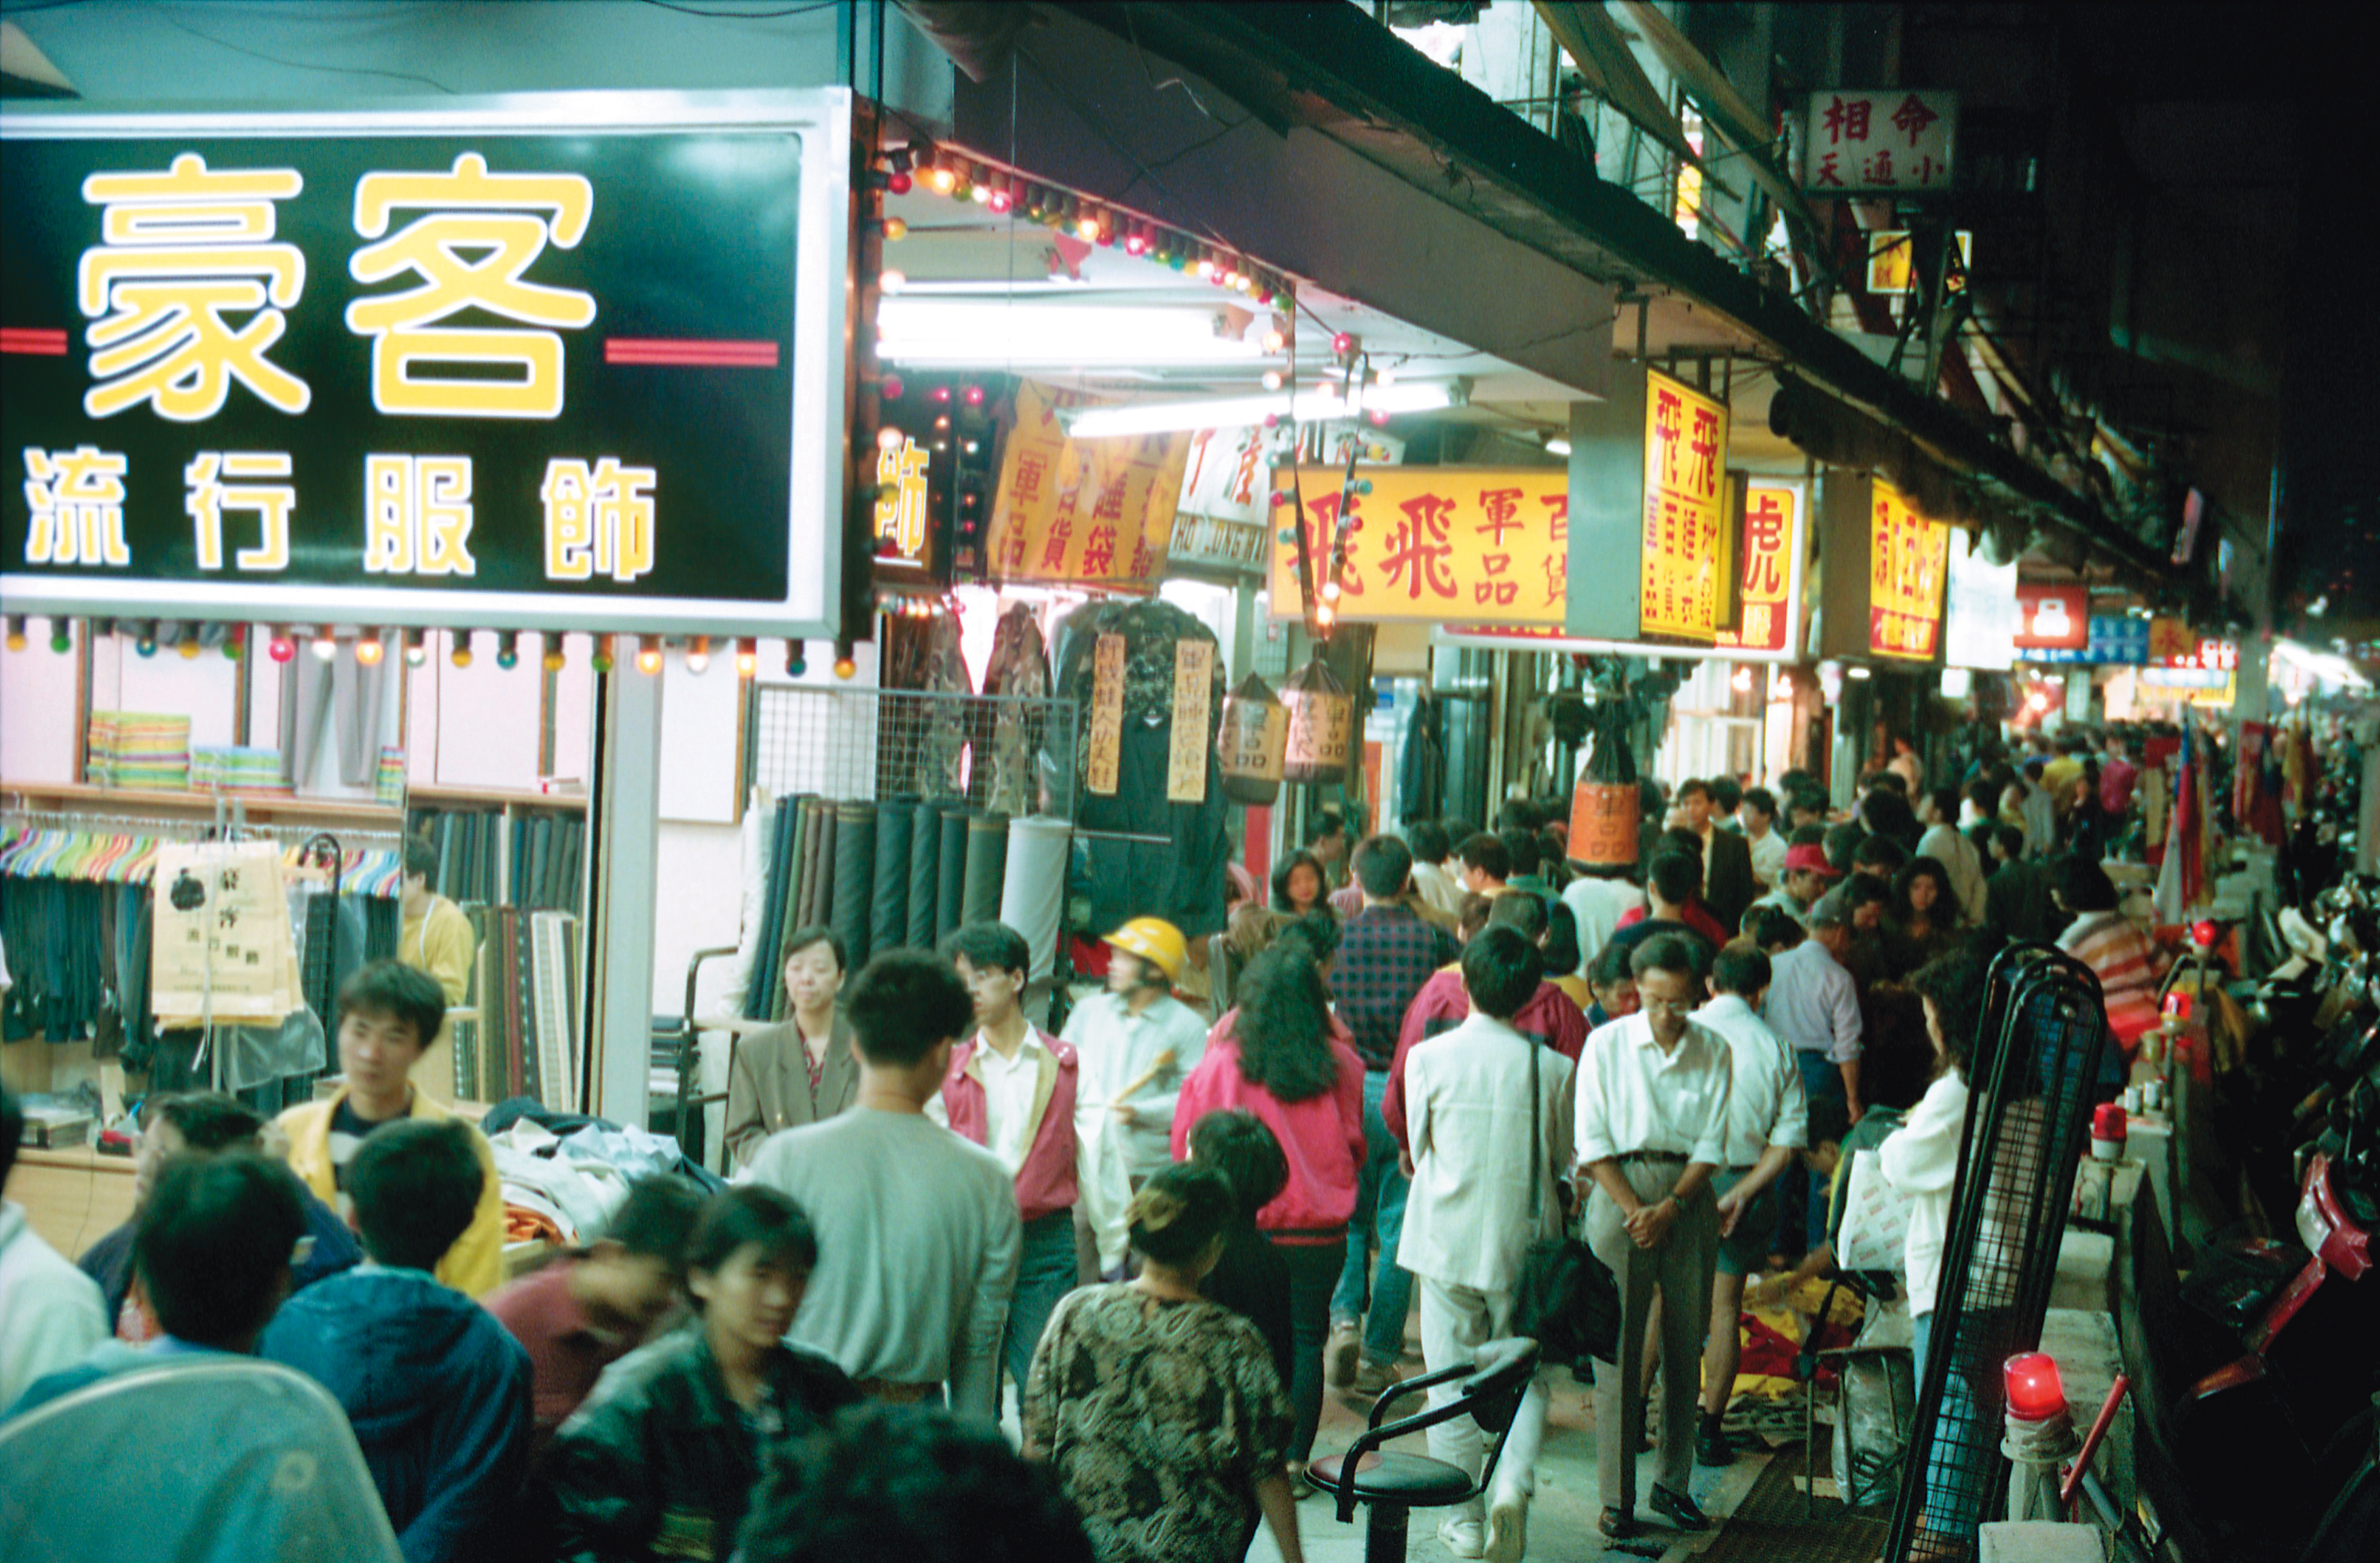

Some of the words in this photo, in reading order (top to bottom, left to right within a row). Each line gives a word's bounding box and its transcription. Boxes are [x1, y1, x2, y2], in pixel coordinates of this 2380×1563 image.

[79, 153, 596, 421] 豪客
[24, 445, 657, 582] 流行服飾
[1286, 491, 1458, 600] 飛飛
[1475, 488, 1524, 606] 軍品
[1745, 495, 1783, 594] 虎
